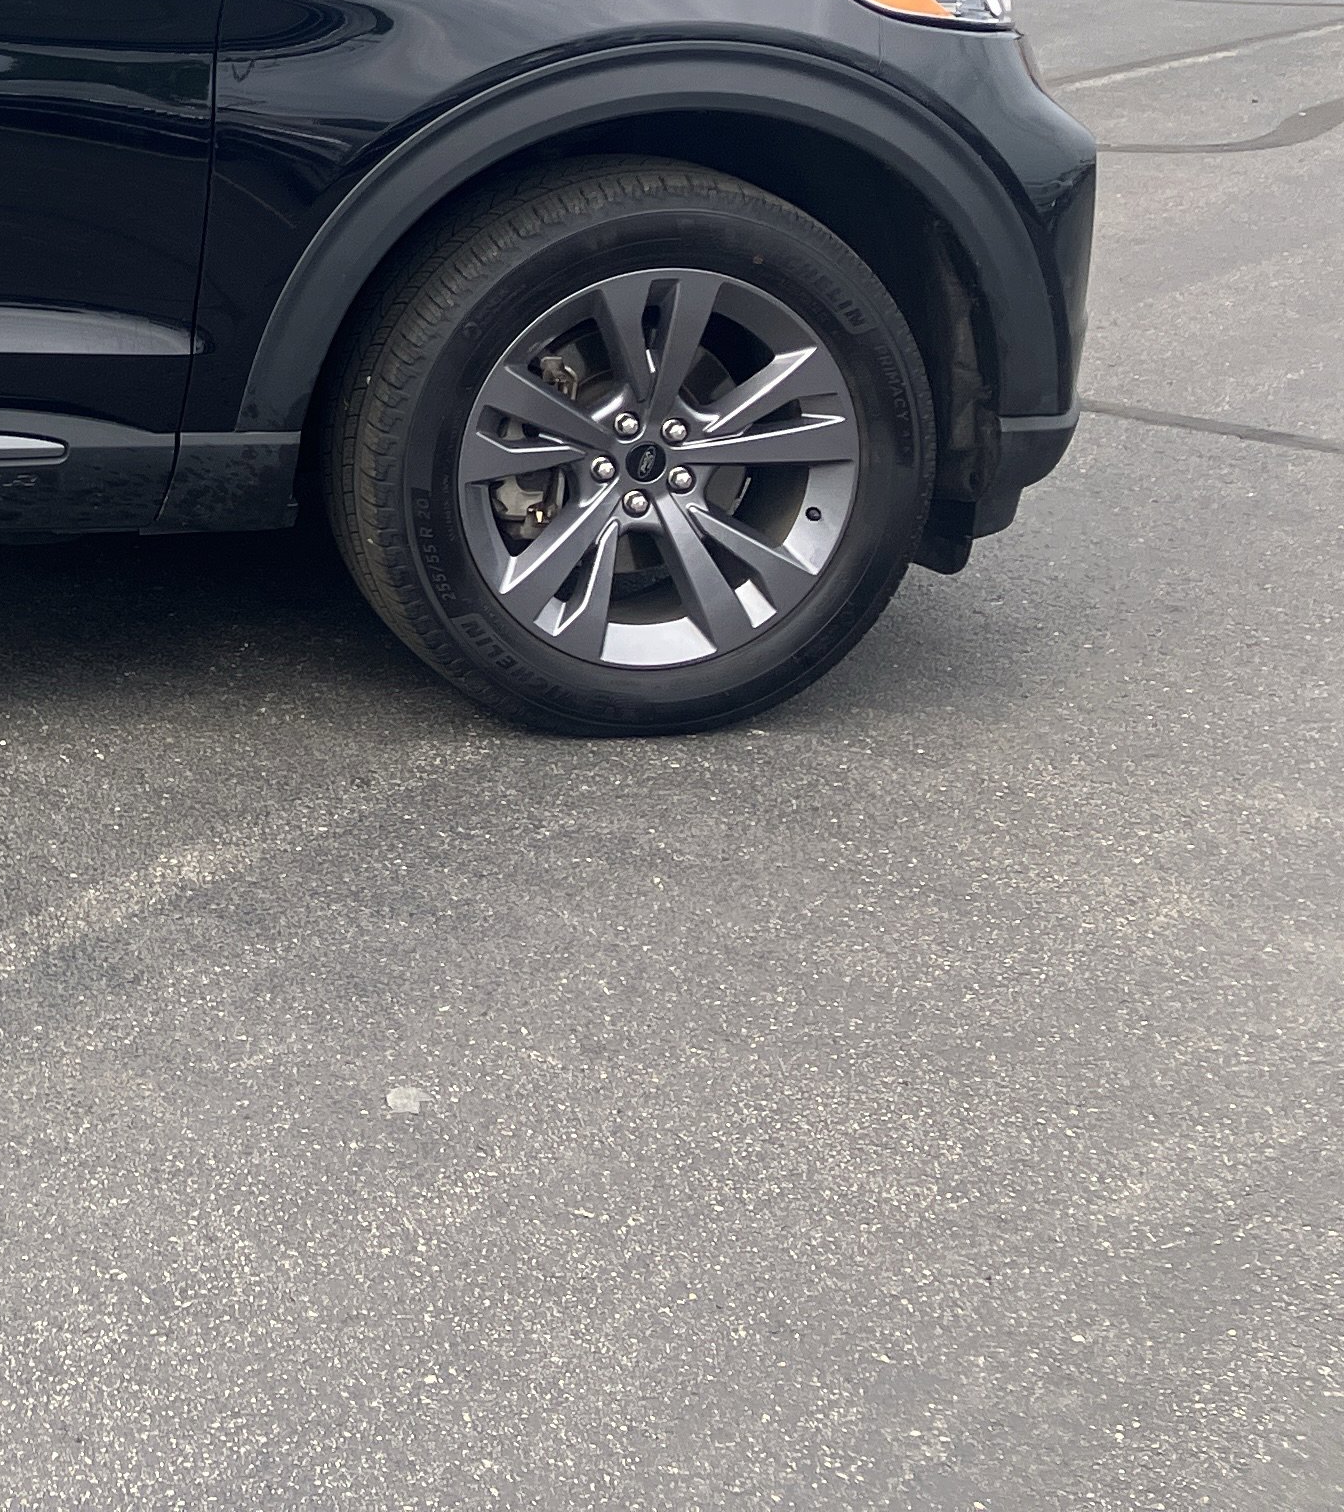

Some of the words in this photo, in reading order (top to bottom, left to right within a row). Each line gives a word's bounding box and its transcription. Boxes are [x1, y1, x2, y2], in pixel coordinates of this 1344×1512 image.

[874, 343, 910, 422] PRIMACY
[415, 497, 431, 521] 20
[423, 544, 457, 601] 255/55
